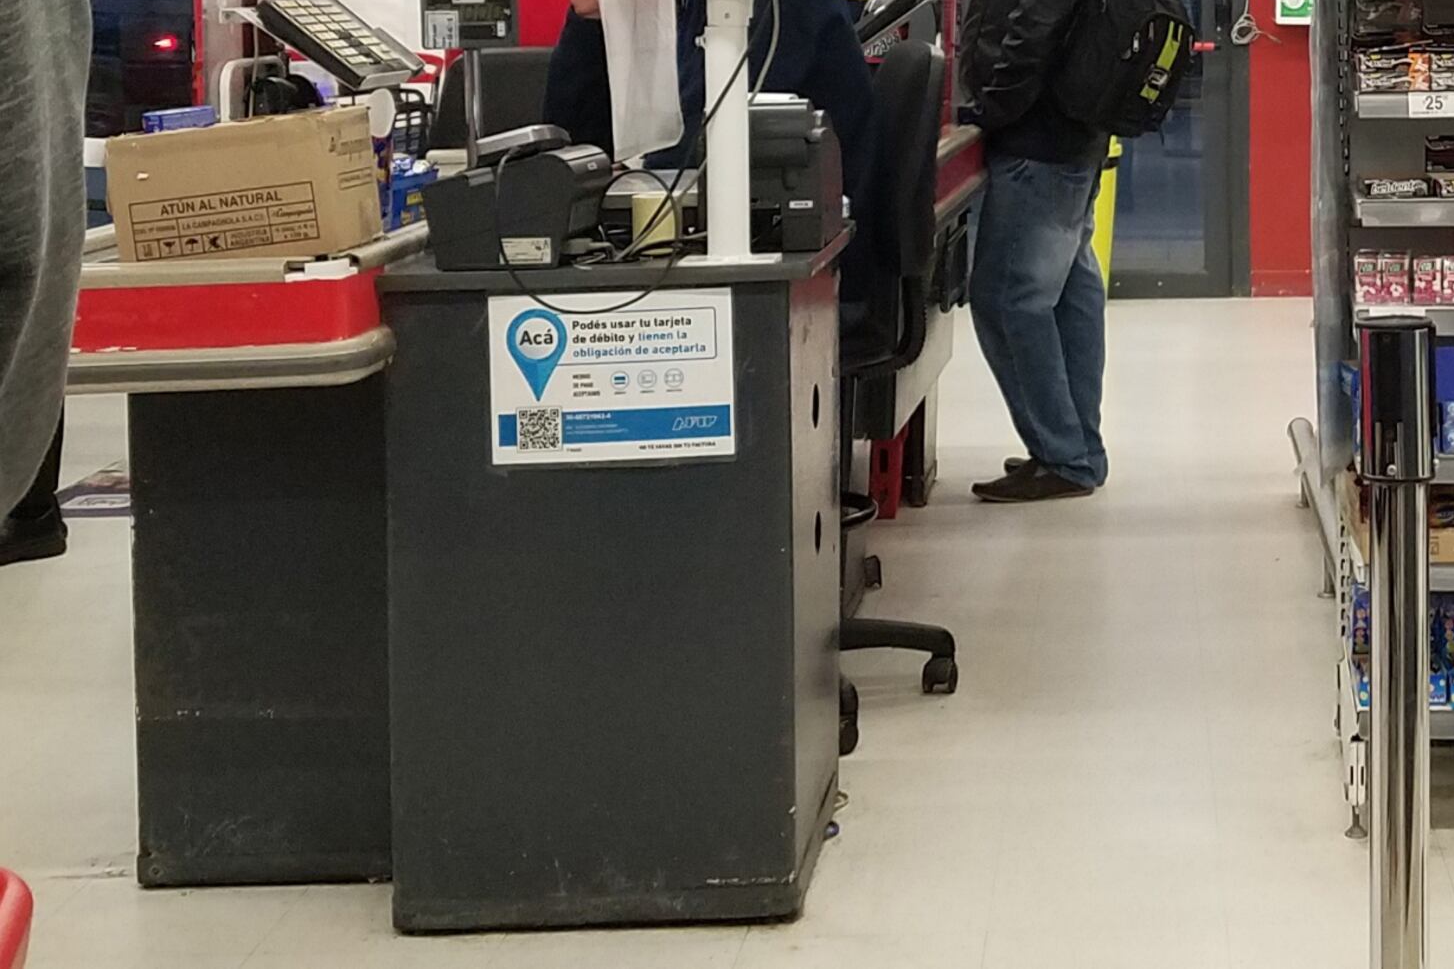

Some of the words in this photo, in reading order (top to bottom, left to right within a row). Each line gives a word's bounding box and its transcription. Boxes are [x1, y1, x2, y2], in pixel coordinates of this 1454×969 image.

[160, 198, 197, 217] ATÚN
[199, 196, 217, 211] AL
[219, 191, 283, 209] NATURAL
[181, 219, 191, 231] LA
[572, 320, 607, 330] Podés
[610, 320, 636, 329] usar
[640, 318, 650, 328] tu
[654, 316, 692, 328] tarjeta
[519, 328, 554, 346] Acá
[572, 334, 586, 344] de
[590, 333, 625, 344] débito
[629, 334, 635, 344] y
[638, 332, 674, 342] tienen
[677, 330, 688, 340] la
[573, 346, 632, 359] obligación
[635, 345, 649, 356] de
[651, 343, 706, 356] aceptarla
